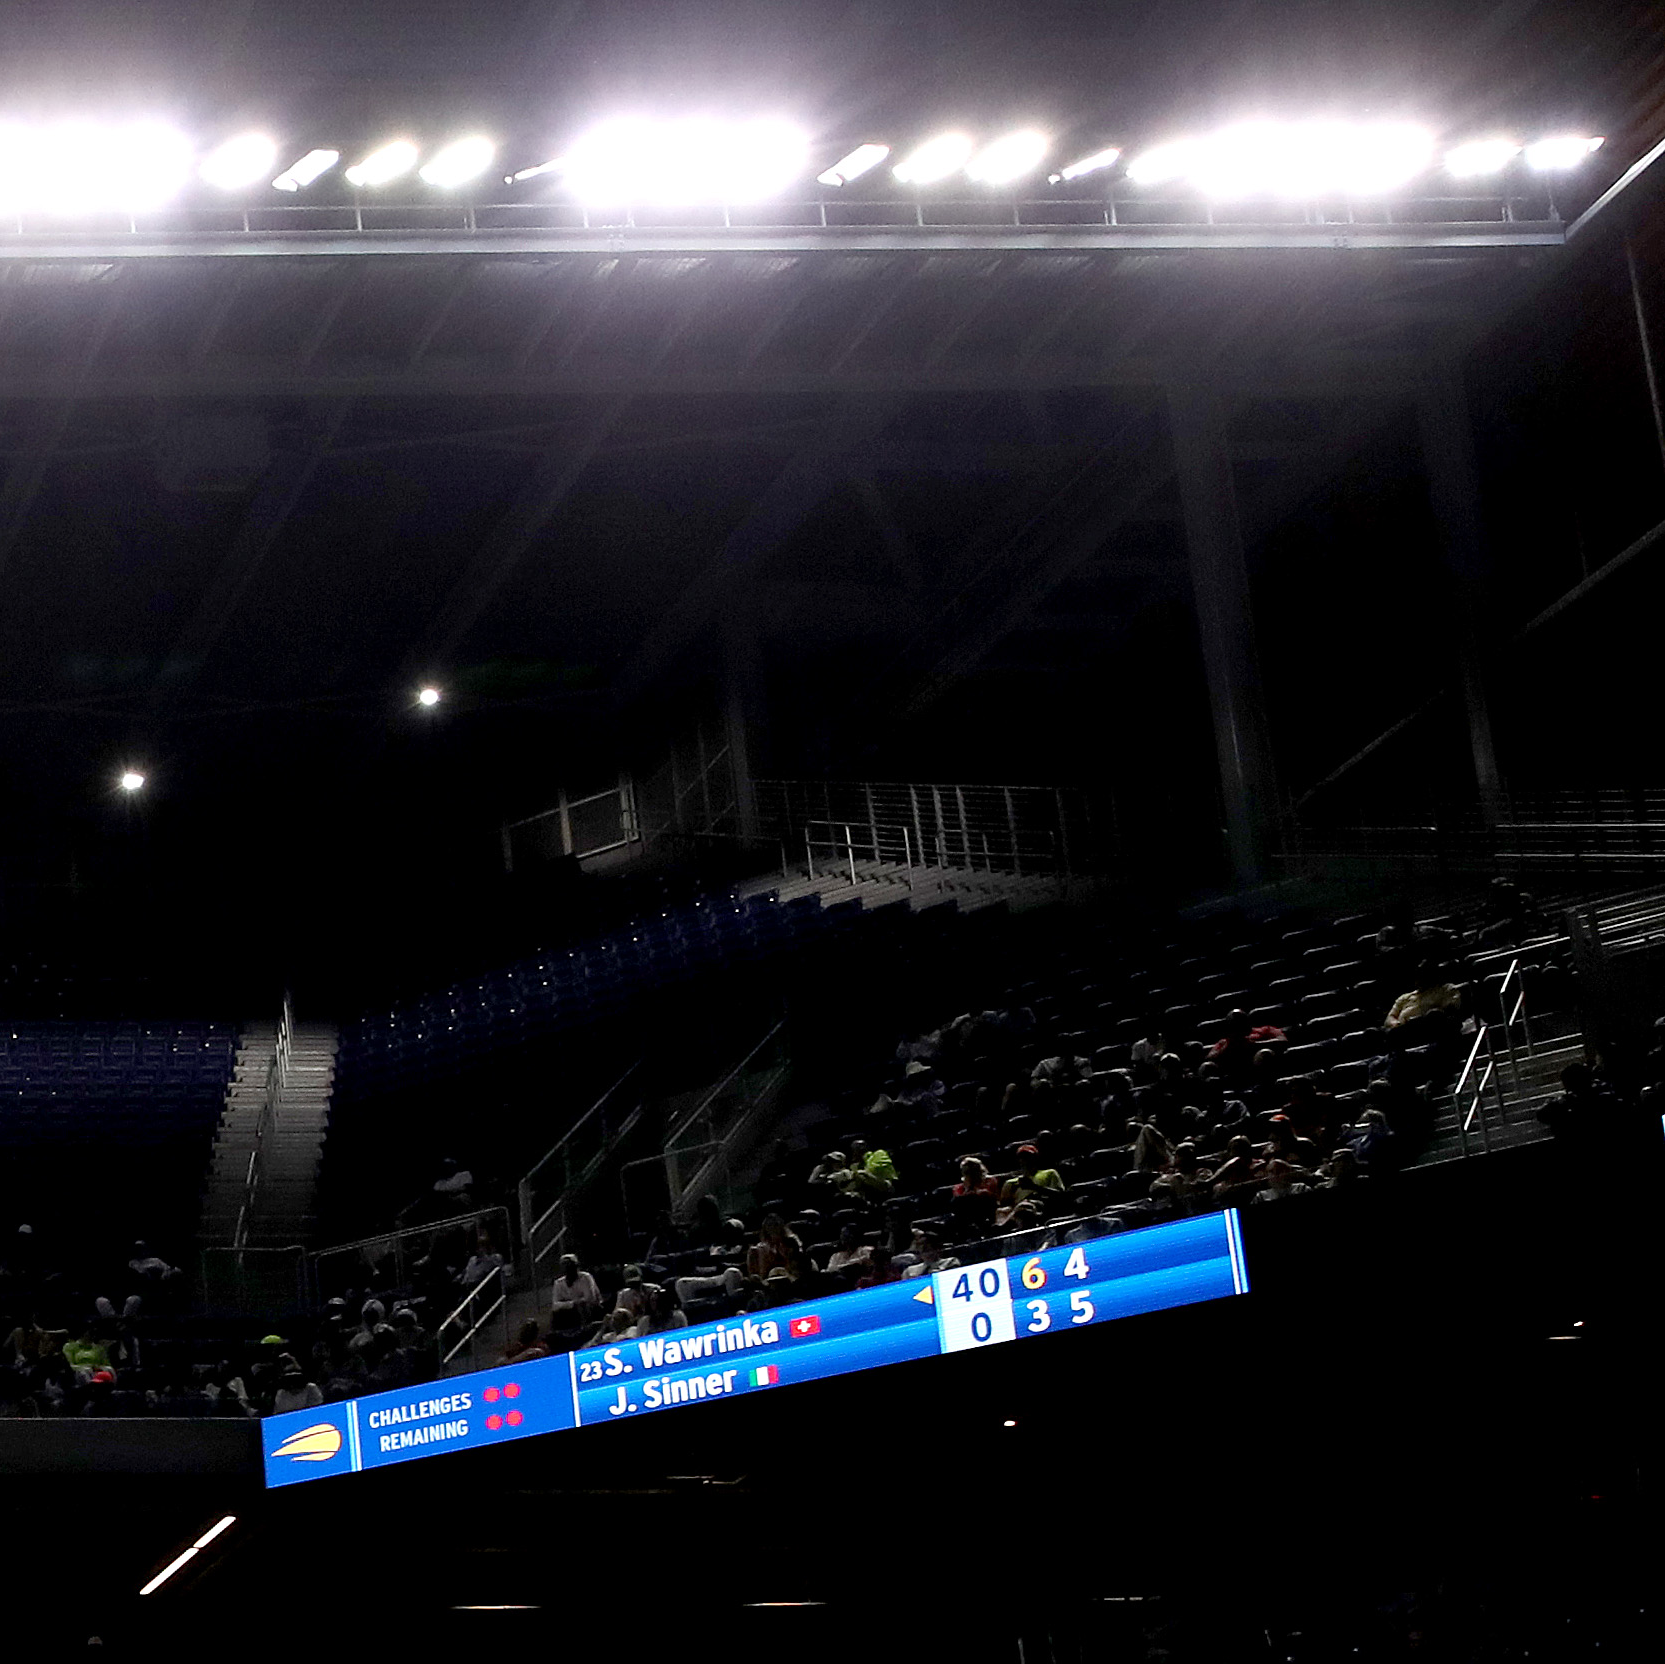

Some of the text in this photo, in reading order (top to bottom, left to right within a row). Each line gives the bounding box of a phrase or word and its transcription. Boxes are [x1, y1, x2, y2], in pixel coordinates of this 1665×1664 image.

[951, 1247, 1090, 1303] 40 6 4
[970, 1290, 1095, 1343] 0 3 5
[580, 1318, 779, 1383] 23 S. Wawrinka
[369, 1392, 472, 1429] CHALLENGES
[608, 1369, 738, 1416] J. Sinner
[380, 1418, 469, 1453] REMAINING
